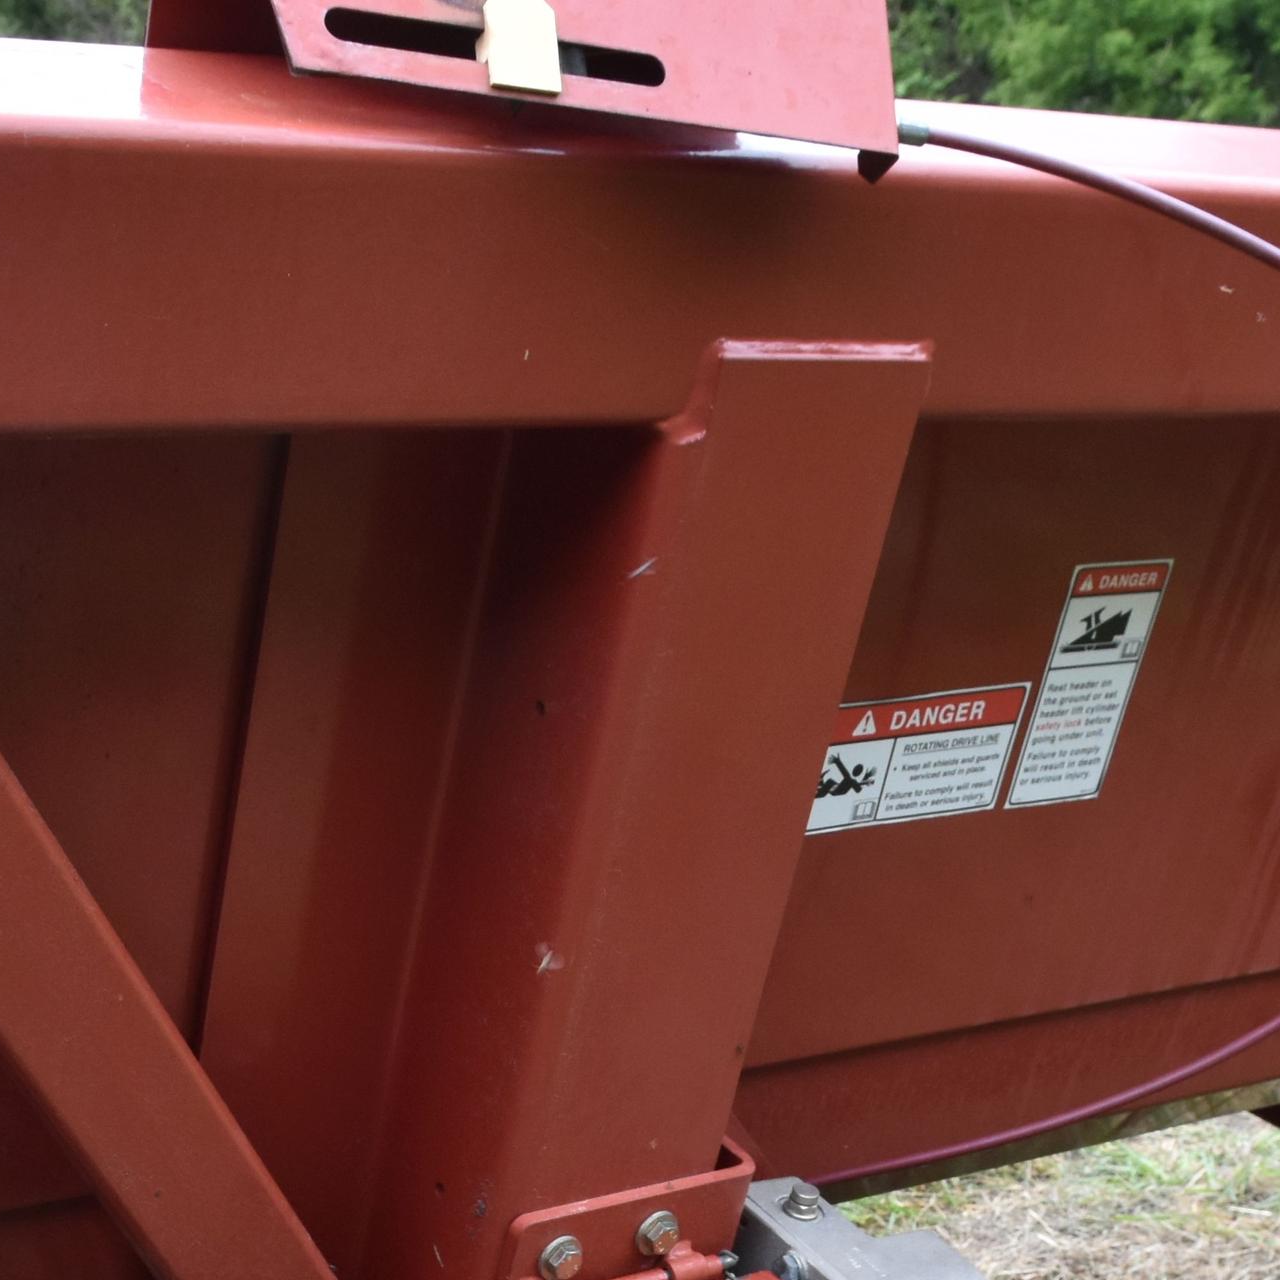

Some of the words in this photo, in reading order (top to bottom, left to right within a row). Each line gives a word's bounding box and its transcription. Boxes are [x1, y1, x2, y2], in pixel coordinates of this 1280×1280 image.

[1099, 572, 1158, 590] DANGER
[1047, 682, 1067, 693] Rest
[1070, 680, 1099, 691] header
[1101, 679, 1113, 687] on
[1043, 695, 1057, 705] the
[1059, 693, 1090, 707] ground
[1104, 691, 1117, 699] set
[890, 700, 986, 730] DANGER
[1040, 707, 1069, 718] header
[1071, 705, 1083, 715] lift
[1086, 702, 1120, 715] cylinder
[1035, 721, 1061, 731] safety
[1064, 719, 1082, 729] lock
[1085, 716, 1112, 726] before
[904, 739, 949, 753] ROTATING
[951, 736, 979, 747] DRIVE
[981, 734, 999, 744] LINE
[1032, 734, 1056, 746] going
[1058, 731, 1083, 741] under
[1086, 729, 1104, 739] unit.
[1028, 750, 1055, 761] Failure
[1059, 749, 1068, 758] to
[1070, 745, 1100, 757] comply
[901, 762, 920, 772] Keep
[923, 761, 932, 769] all
[934, 758, 959, 769] shields
[961, 756, 974, 765] and
[976, 753, 999, 764] guards
[1023, 764, 1037, 773] will
[1040, 761, 1065, 772] result
[1078, 756, 1101, 767] death
[910, 771, 942, 782] serviced
[944, 769, 957, 778] and
[966, 765, 986, 776] place.
[1031, 775, 1062, 785] serious
[1065, 771, 1089, 783] injury.
[885, 789, 912, 800] Failure
[914, 789, 922, 797] to
[924, 784, 953, 795] comply
[955, 783, 969, 792] will
[971, 779, 993, 789] result
[886, 803, 893, 811] in
[895, 800, 918, 811] death
[920, 800, 928, 808] or
[931, 796, 960, 806] serious
[962, 793, 985, 804] injury.
